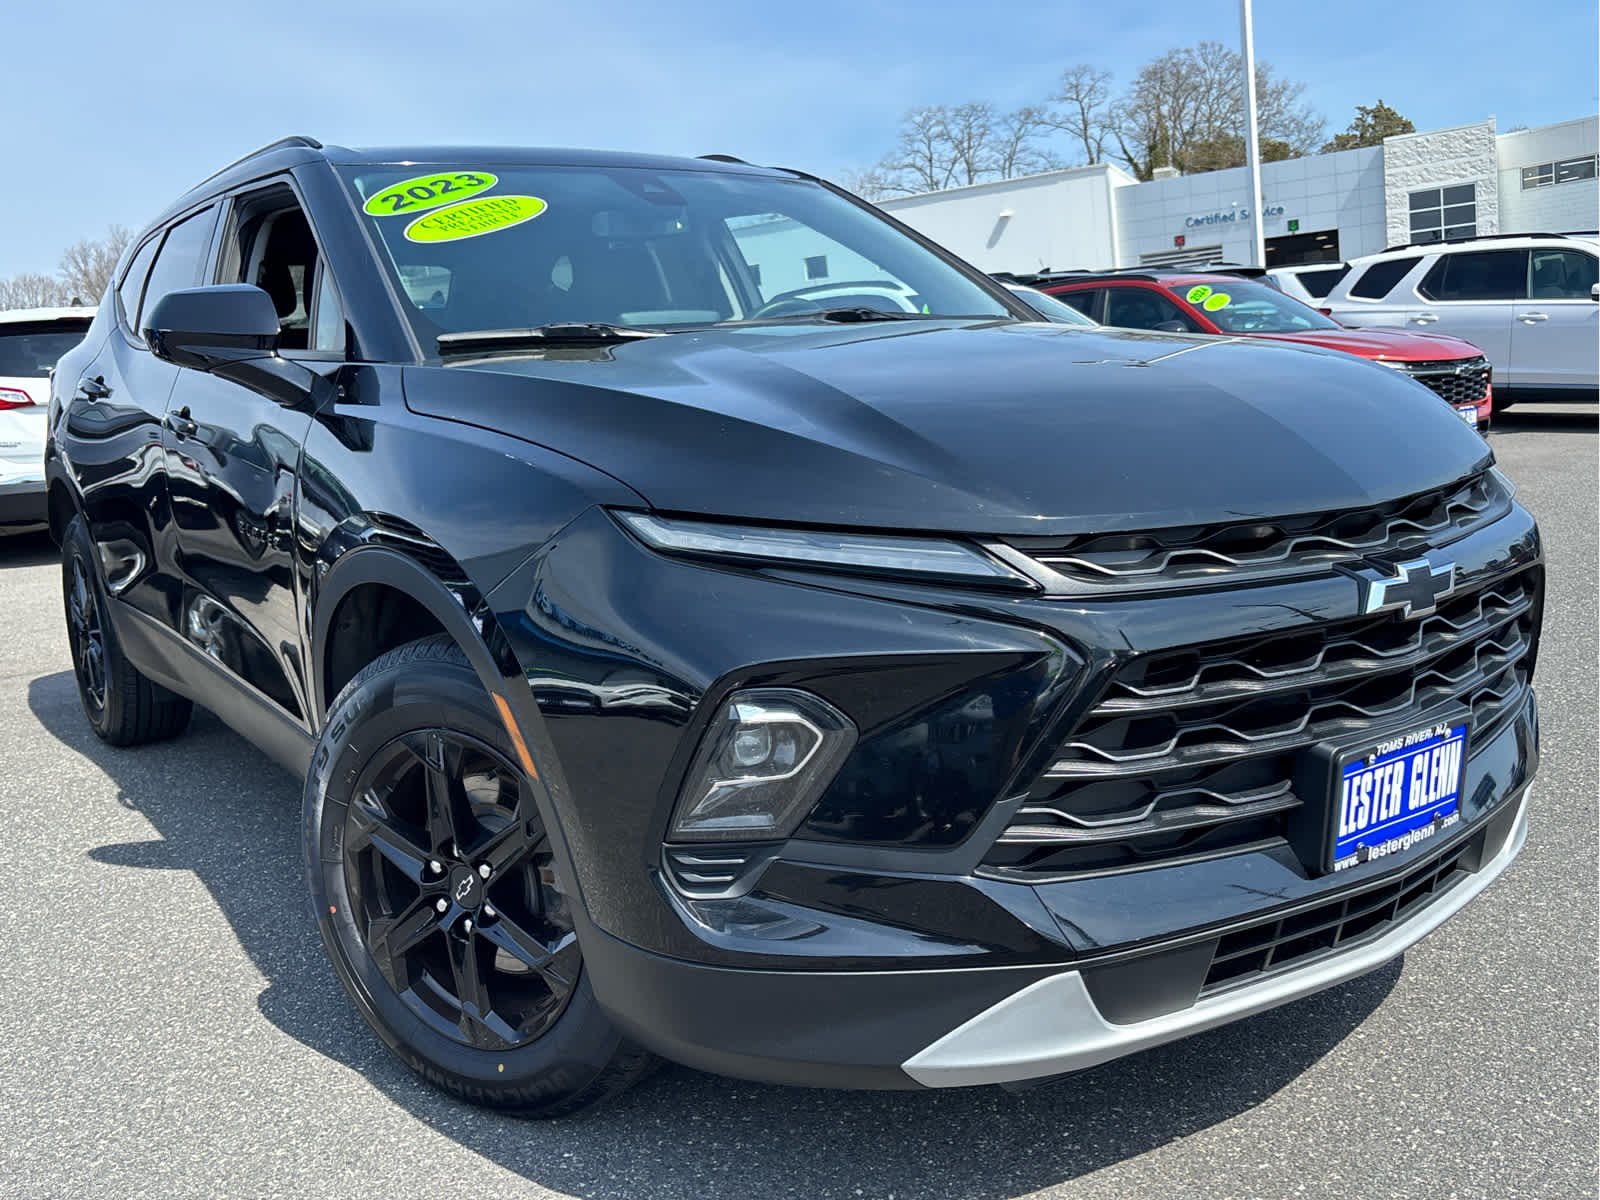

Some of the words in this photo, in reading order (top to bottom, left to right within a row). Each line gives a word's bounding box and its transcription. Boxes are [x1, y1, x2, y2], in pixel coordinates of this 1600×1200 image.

[381, 174, 485, 211] 2023
[420, 199, 518, 229] CERTIFIED
[1185, 210, 1236, 228] Certified
[1376, 738, 1403, 757] TOMS
[1435, 722, 1448, 736] NJ
[1339, 761, 1405, 837] LESTER
[1408, 740, 1463, 811] GLENN
